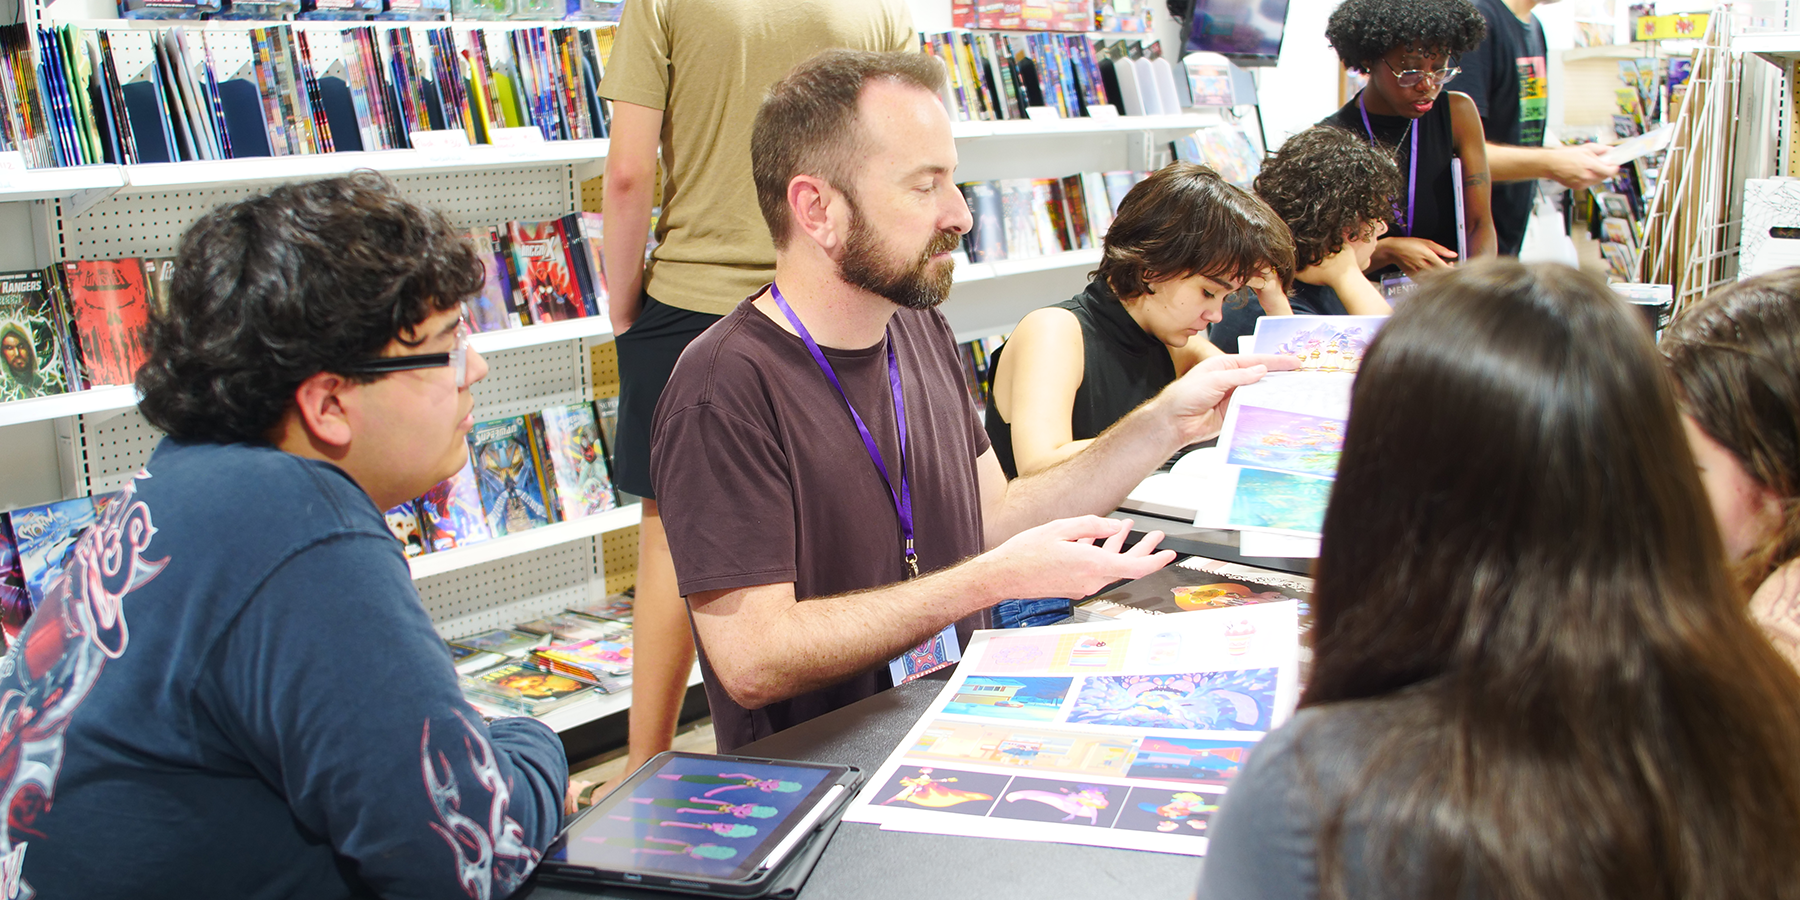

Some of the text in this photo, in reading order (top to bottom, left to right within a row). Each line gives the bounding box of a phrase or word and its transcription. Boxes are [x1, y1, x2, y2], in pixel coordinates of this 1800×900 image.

[2, 280, 42, 294] RANGERS
[83, 268, 131, 287] PUNISHER
[474, 424, 518, 446] SUPERMAN
[17, 506, 59, 548] STORM
